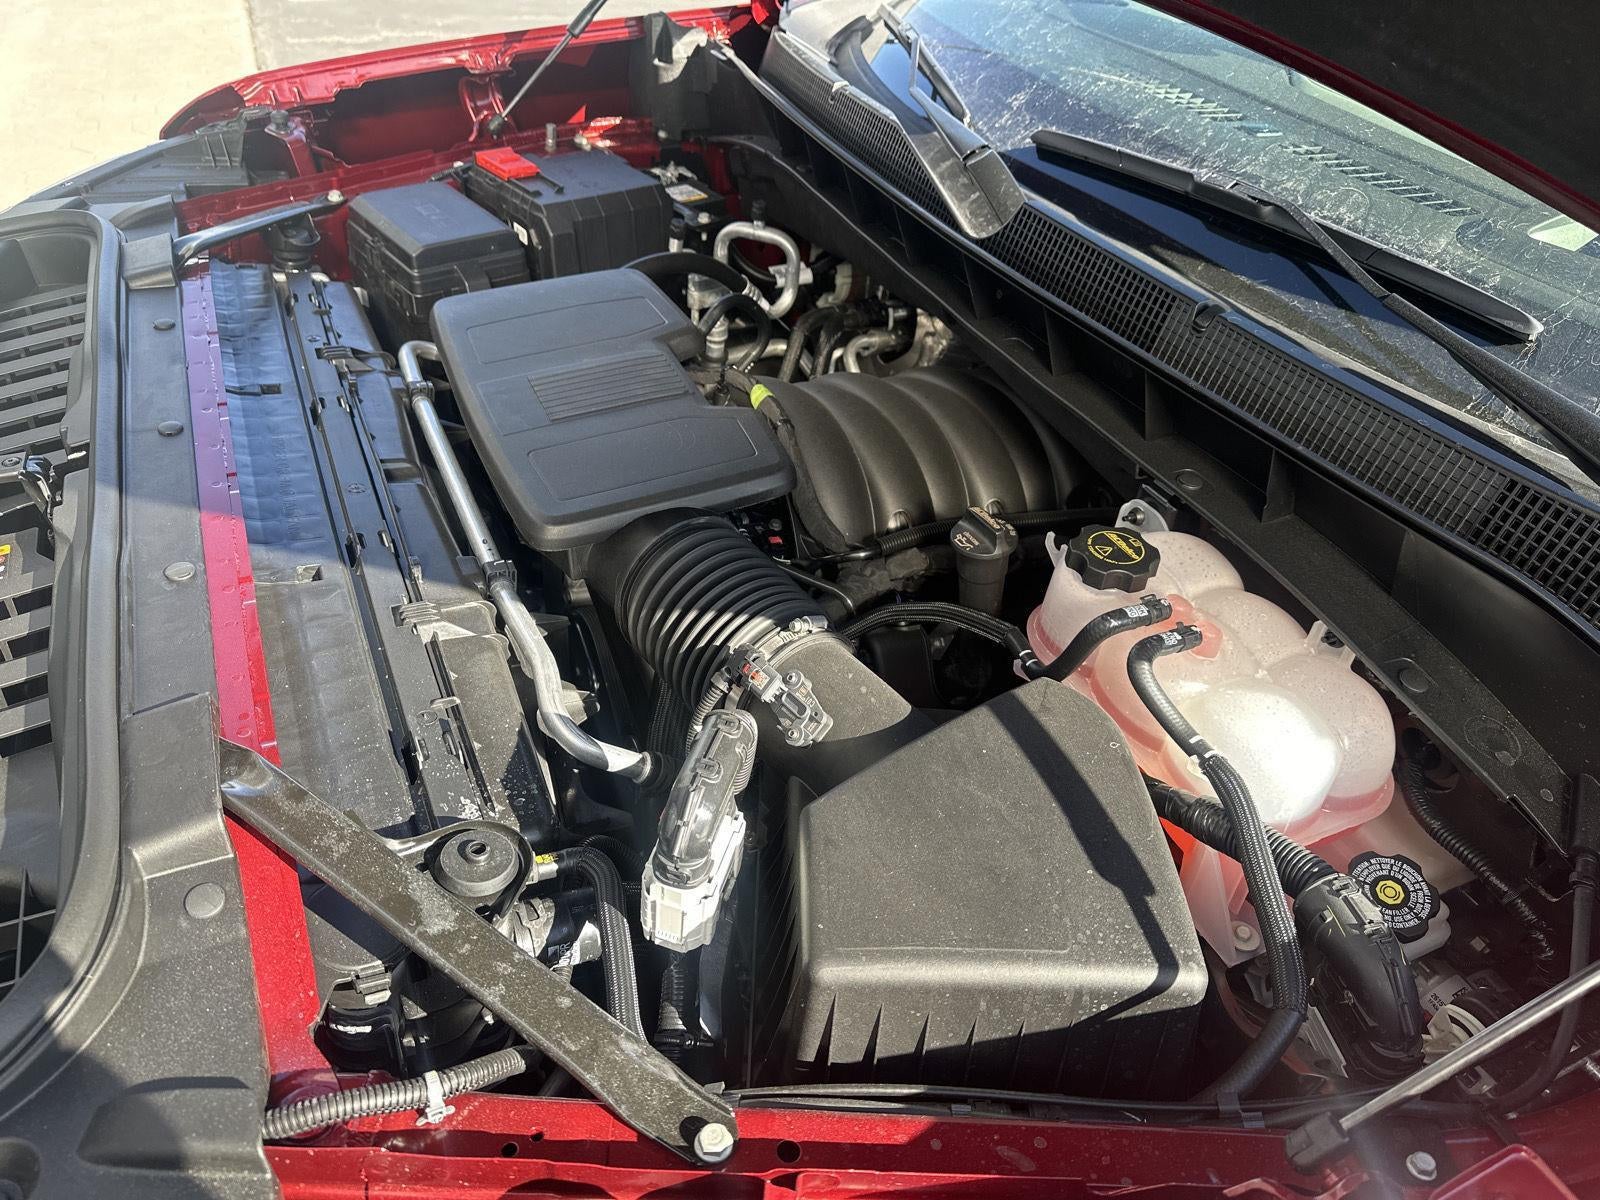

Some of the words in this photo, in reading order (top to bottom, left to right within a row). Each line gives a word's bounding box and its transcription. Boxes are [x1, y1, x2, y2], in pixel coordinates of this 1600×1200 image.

[1352, 860, 1370, 877] TTENTION:
[1402, 864, 1423, 882] BOUCHON
[1420, 881, 1431, 898] AVANT
[1399, 868, 1418, 885] LIQUIDE
[1392, 907, 1410, 916] FILLER
[1403, 912, 1416, 922] ONLY
